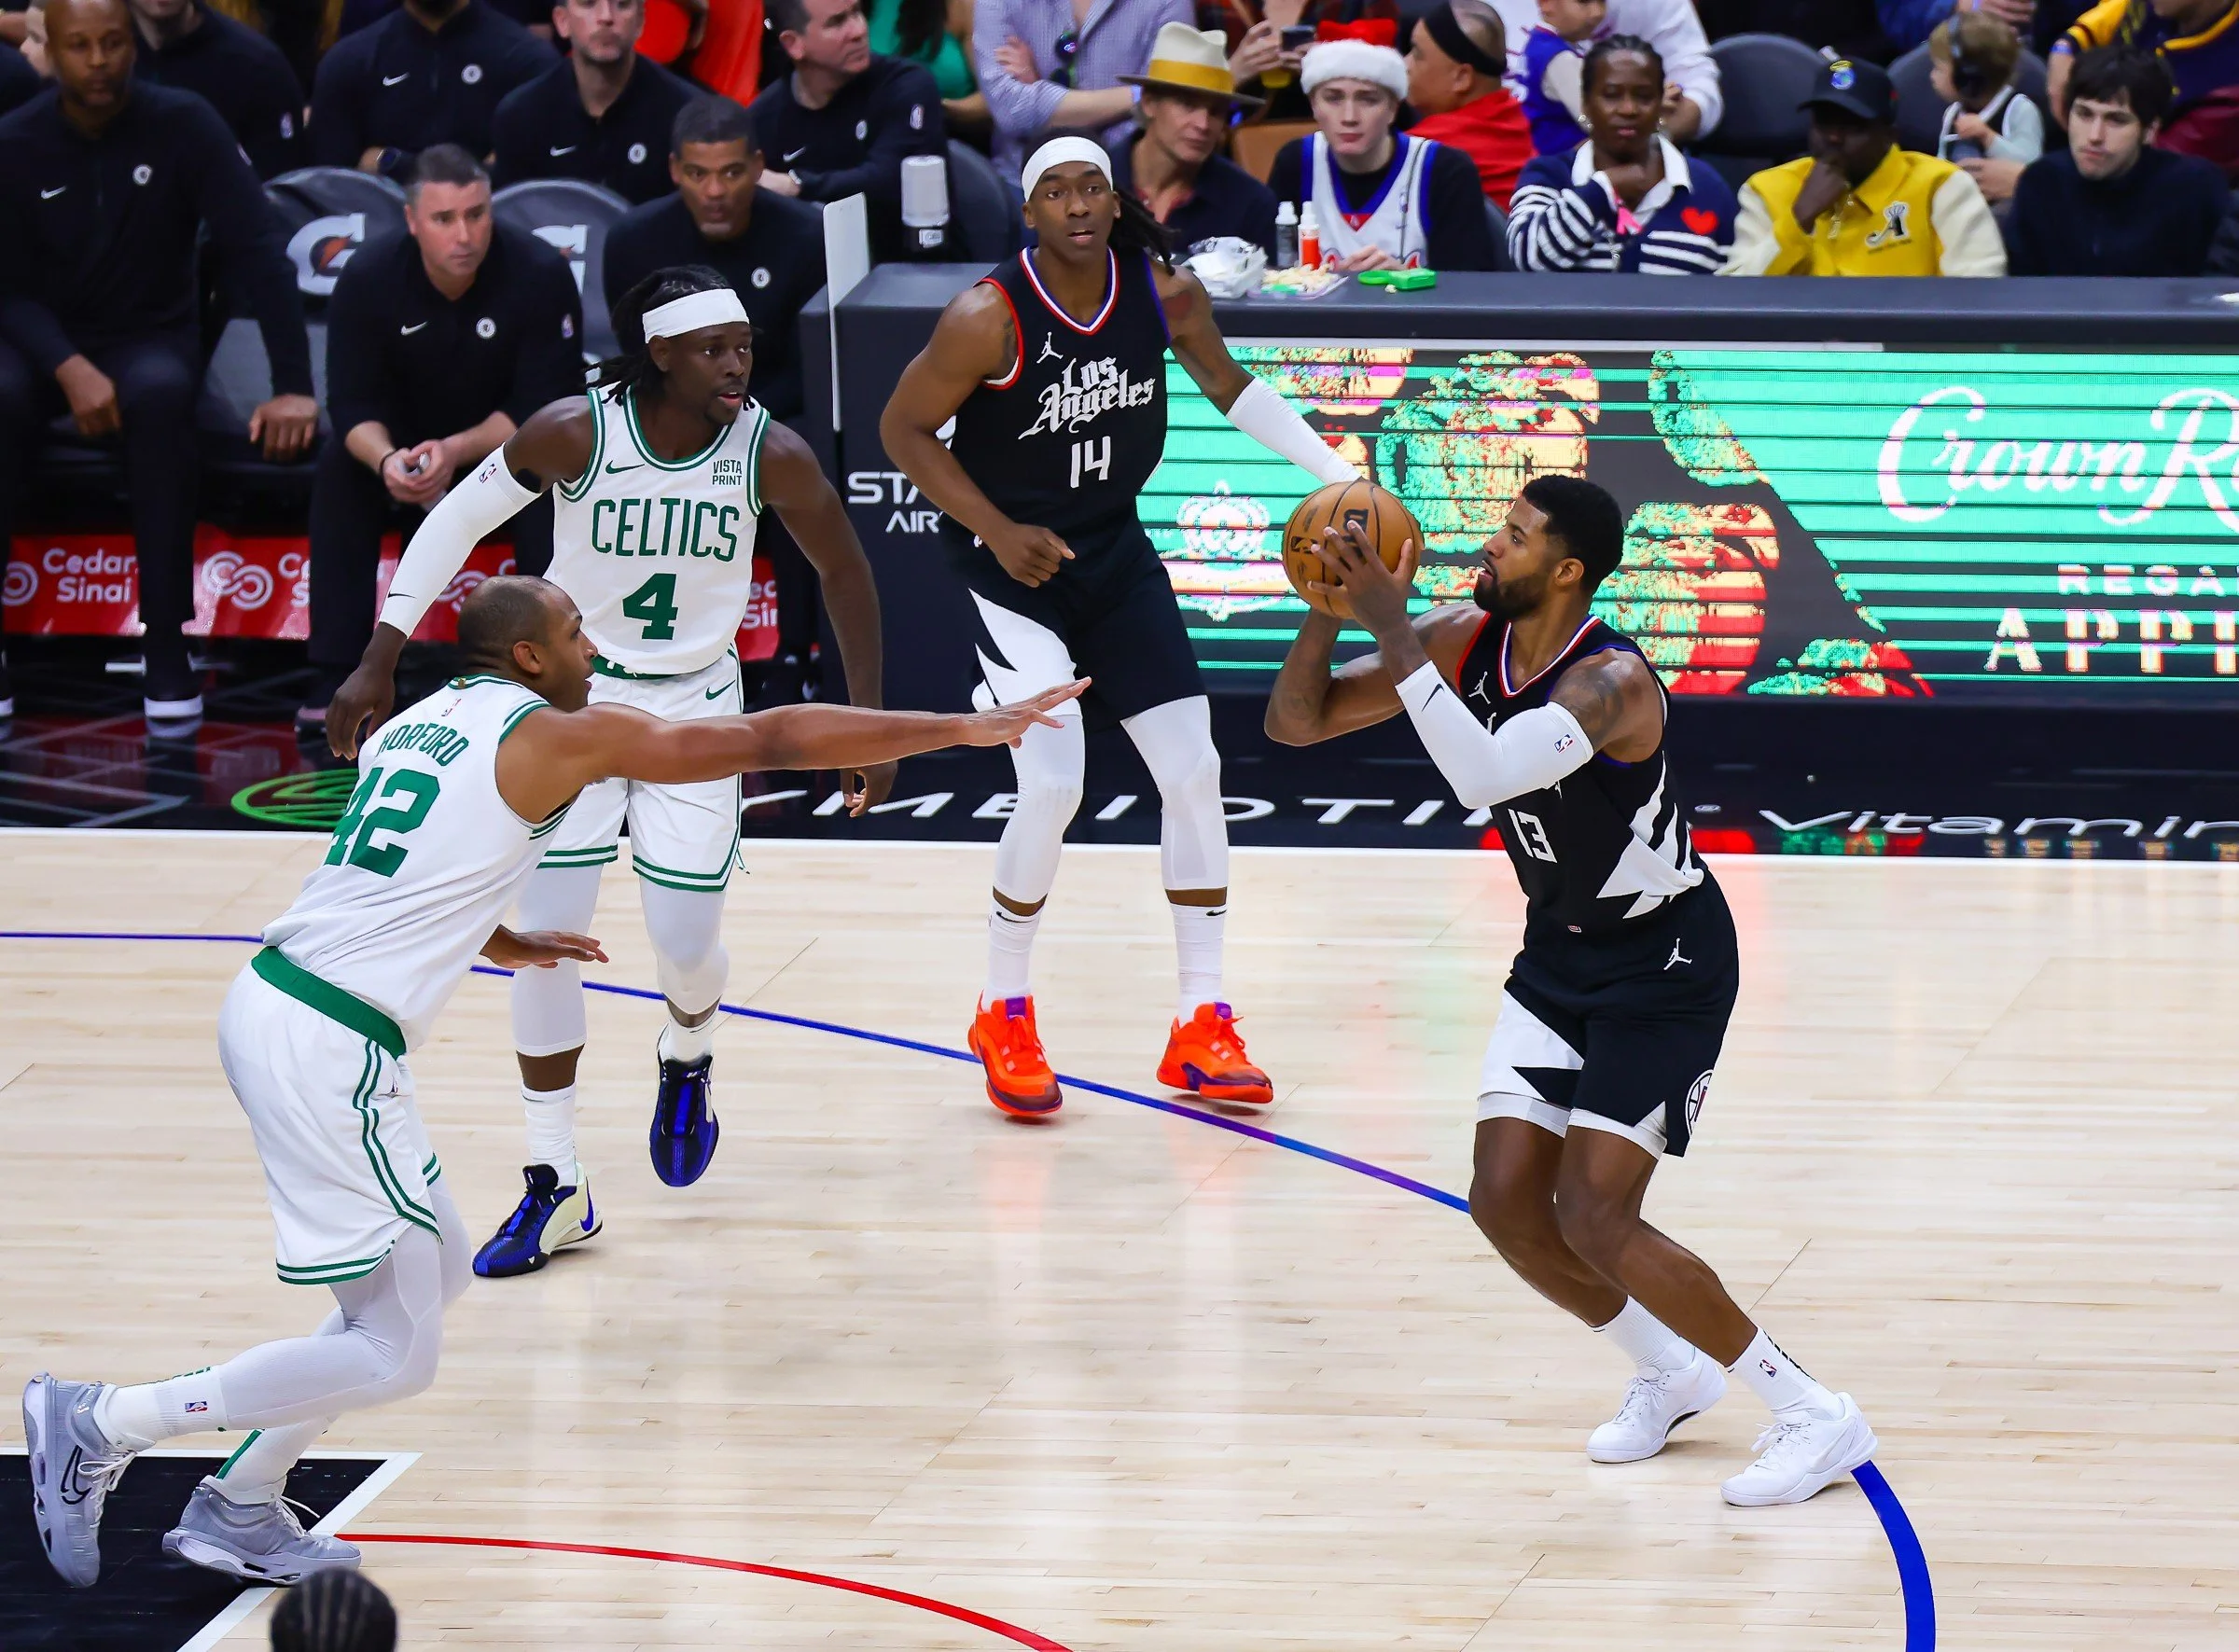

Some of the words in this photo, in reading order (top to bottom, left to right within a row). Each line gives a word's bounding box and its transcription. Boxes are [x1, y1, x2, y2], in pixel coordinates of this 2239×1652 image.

[1060, 356, 1120, 399] Los
[1018, 368, 1156, 440] Angeles
[712, 475, 743, 486] PRINT
[713, 459, 743, 474] VISTA
[1070, 436, 1111, 489] 14
[1877, 386, 2146, 523] Crown
[2095, 388, 2239, 537] R
[591, 497, 740, 562] CELTICS
[885, 510, 944, 534] AIR
[43, 547, 139, 576] Cedar
[2057, 564, 2239, 597] REGA
[56, 576, 132, 604] Sinai
[622, 573, 679, 641] 4
[374, 722, 469, 767] HORFORD
[323, 767, 441, 878] 42
[1508, 808, 1558, 864] 13
